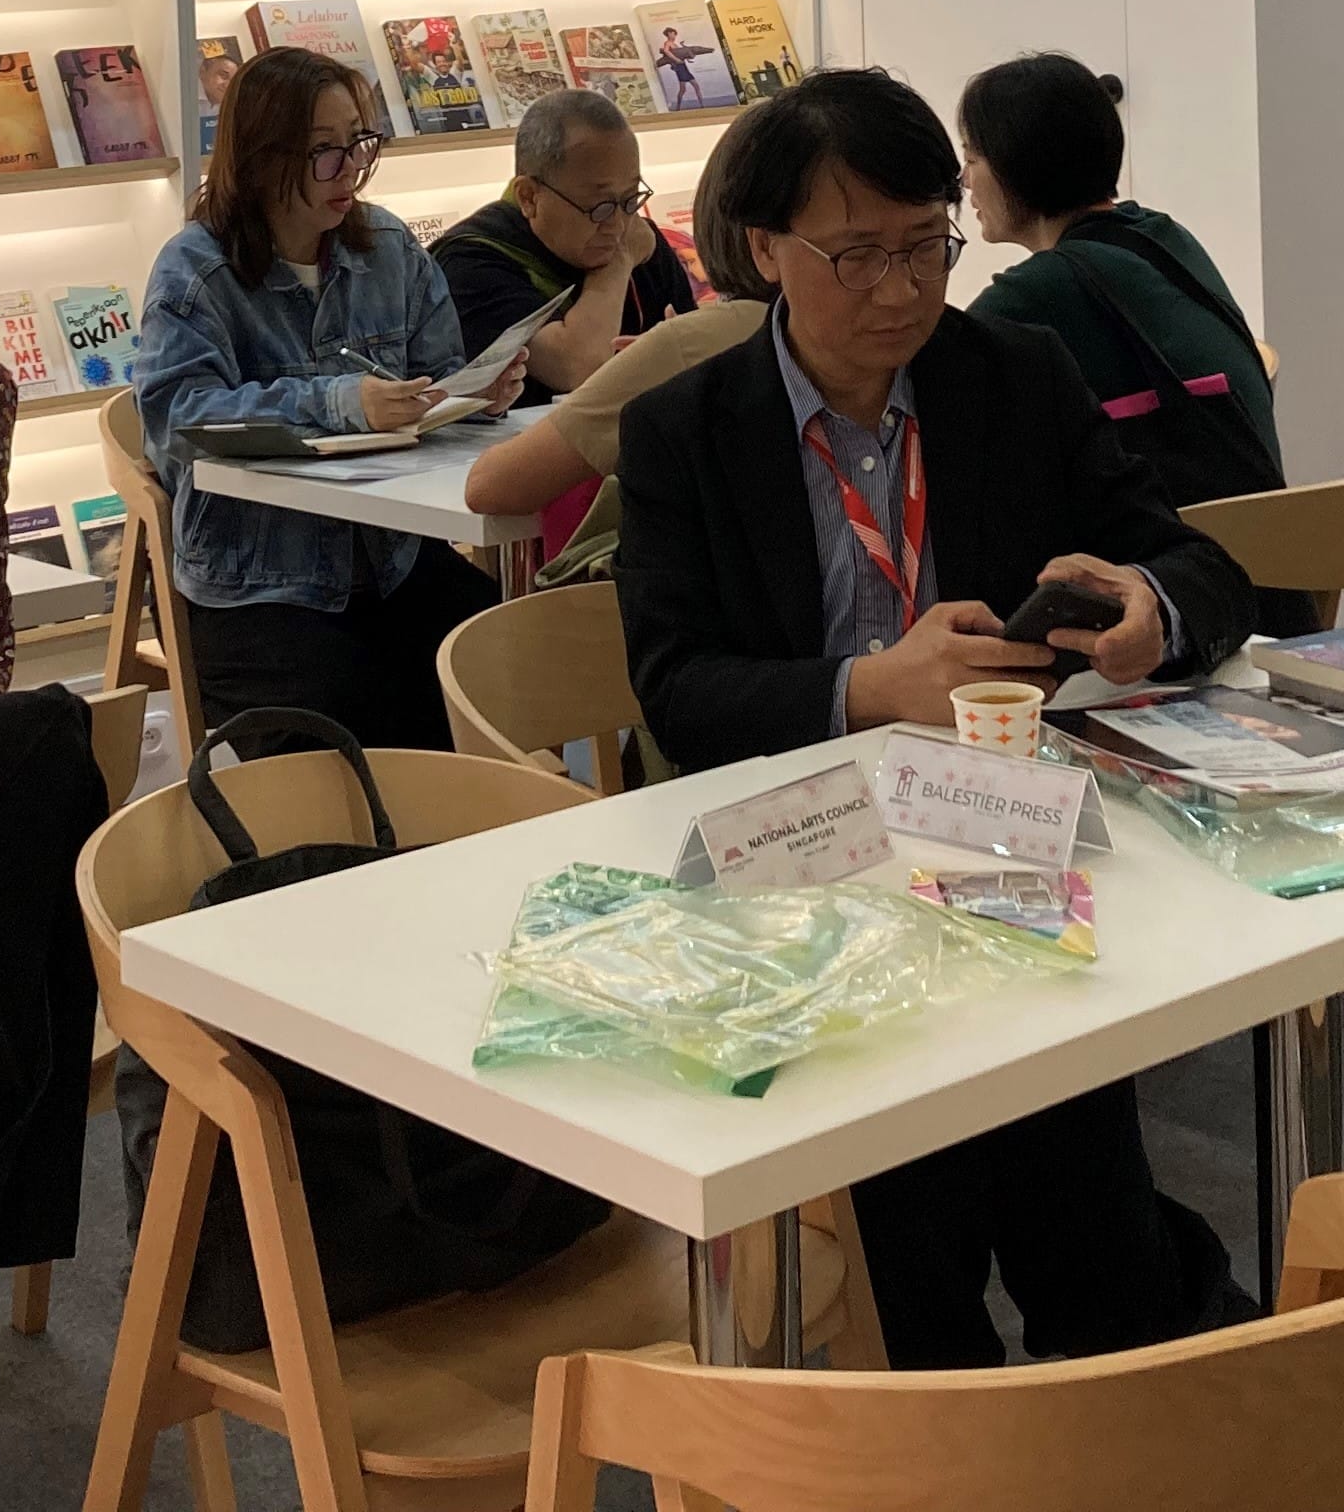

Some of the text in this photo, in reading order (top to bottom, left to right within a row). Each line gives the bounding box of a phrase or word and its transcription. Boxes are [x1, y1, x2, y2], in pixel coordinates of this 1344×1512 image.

[729, 16, 756, 27] HARD
[747, 23, 776, 34] WORK
[14, 348, 44, 366] ME
[12, 364, 48, 383] AH
[921, 781, 1064, 826] BALESTIER PRESS
[747, 797, 870, 850] NATIONAL ARTS COUNCIL
[786, 825, 836, 852] SINGAPORE
